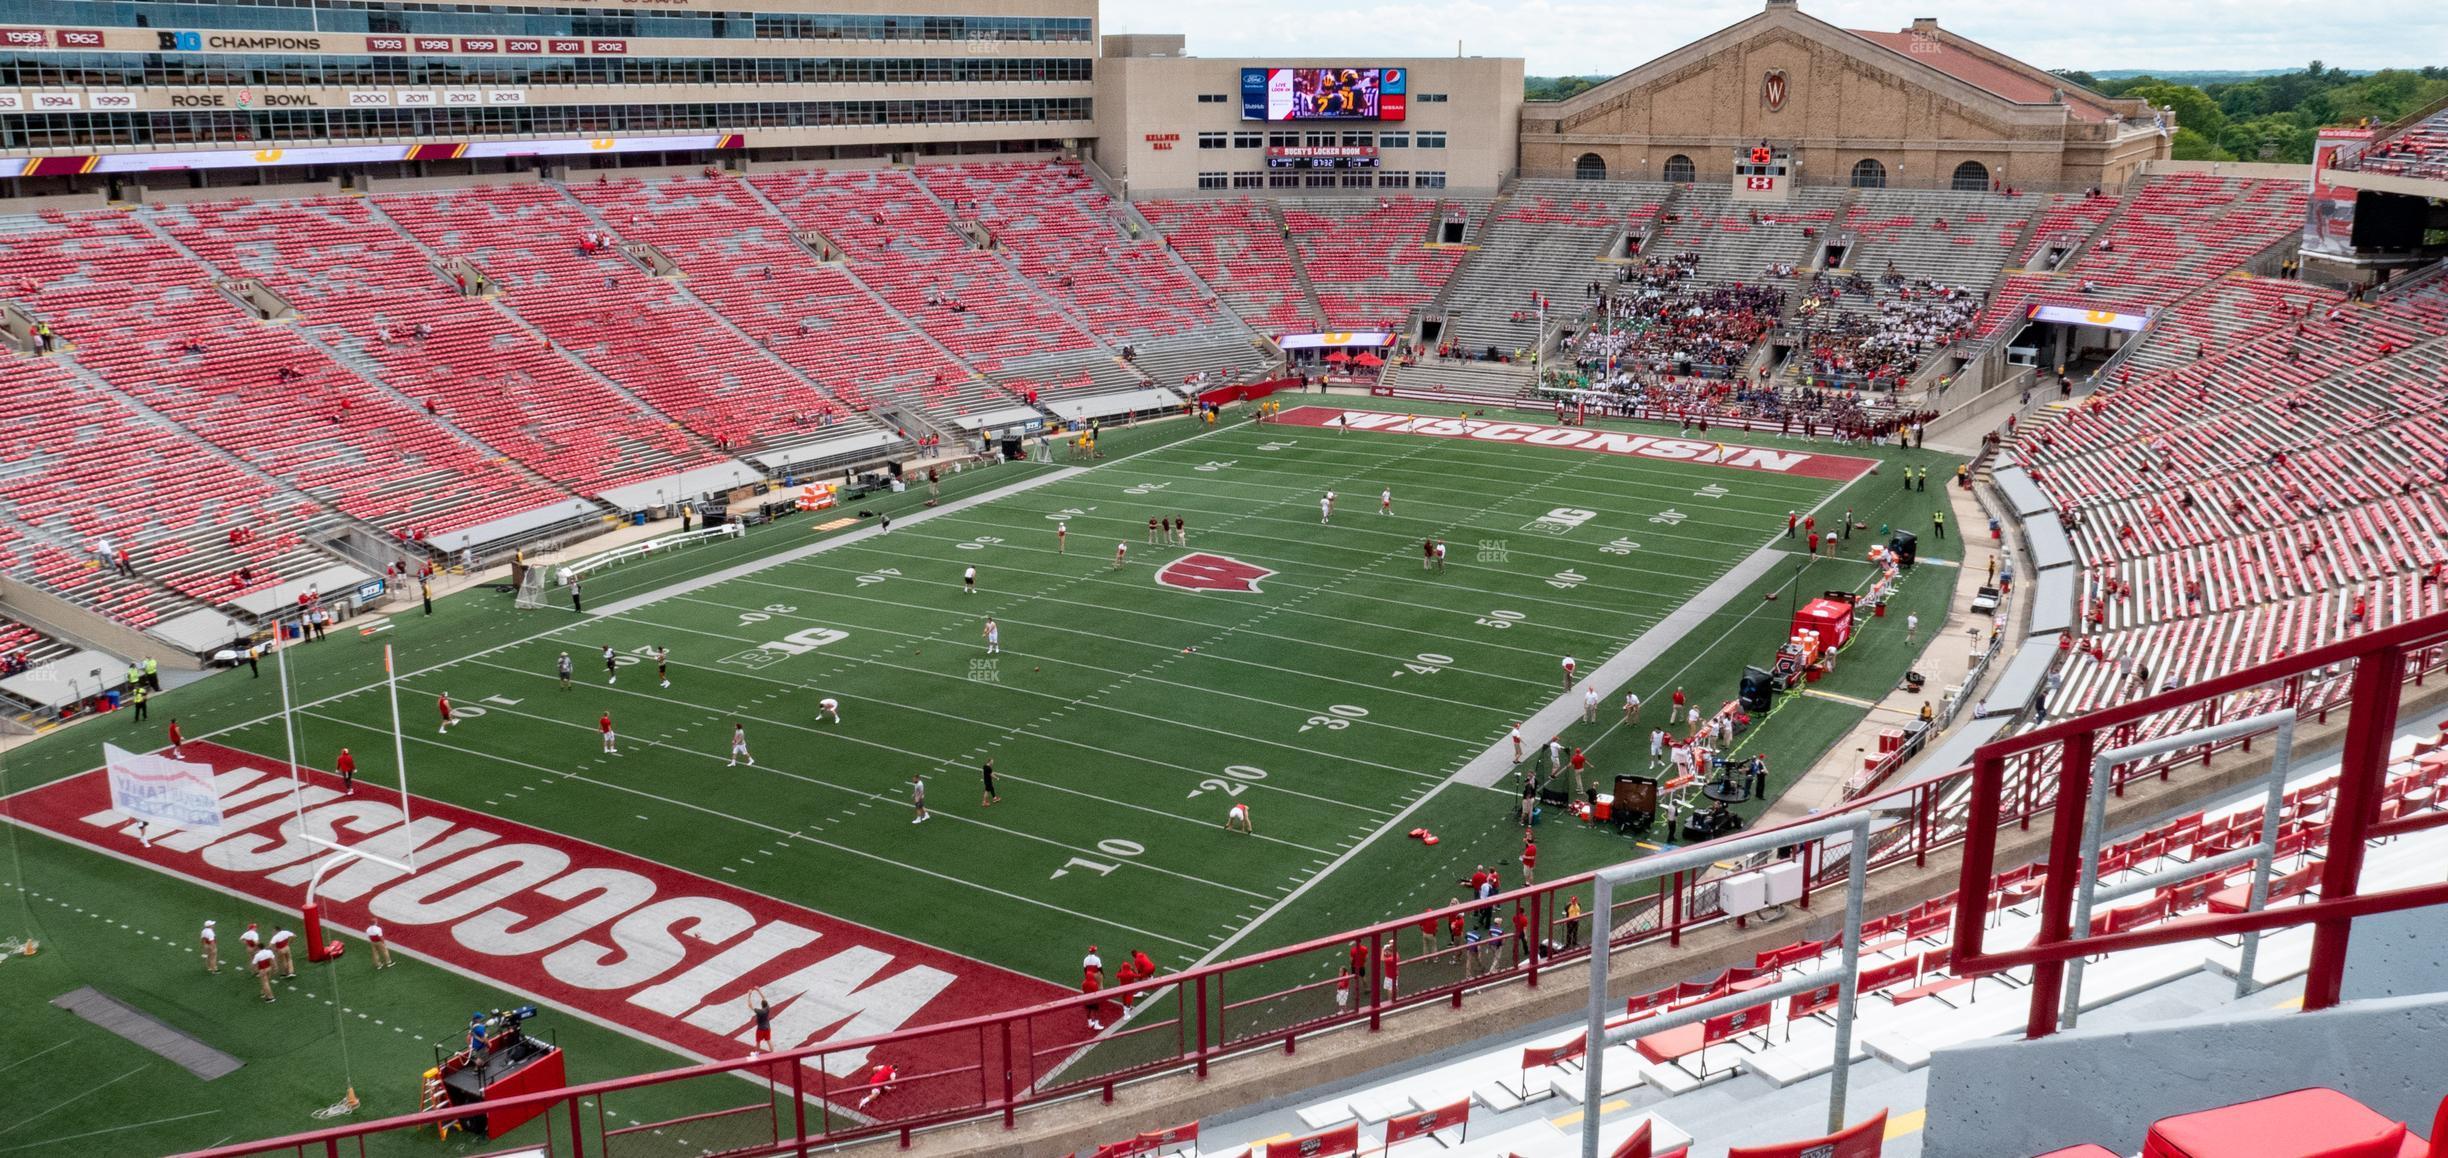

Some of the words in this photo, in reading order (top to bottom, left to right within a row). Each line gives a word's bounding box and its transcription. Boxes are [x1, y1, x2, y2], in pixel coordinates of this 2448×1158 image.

[6, 32, 42, 43] 1959
[64, 33, 99, 44] 1962
[209, 36, 321, 50] CHAMPIONS
[373, 39, 402, 49] 1993
[420, 40, 449, 50] 1998
[467, 41, 494, 50] 1999
[511, 42, 538, 51] 2010
[556, 42, 579, 51] 2011
[598, 43, 623, 52] 2012
[40, 97, 74, 107] 1994
[97, 97, 130, 106] 1999
[172, 95, 225, 107] ROSE
[264, 95, 318, 106] BOWL
[352, 94, 387, 104] 2000
[406, 94, 429, 103] 2011
[450, 94, 476, 103] 2012
[495, 93, 520, 102] 2013
[1768, 81, 1783, 103] W
[1153, 142, 1173, 151] HALL
[1284, 147, 1312, 155] BUCKY'S
[1313, 147, 1340, 155] LOCKER
[1752, 147, 1770, 163] 25
[1323, 410, 1811, 472] WISCONSIN
[1475, 609, 1527, 629] 50
[1403, 653, 1455, 676] 40
[1308, 704, 1370, 731] 30
[1200, 765, 1268, 797] 20
[1063, 838, 1145, 878] 10
